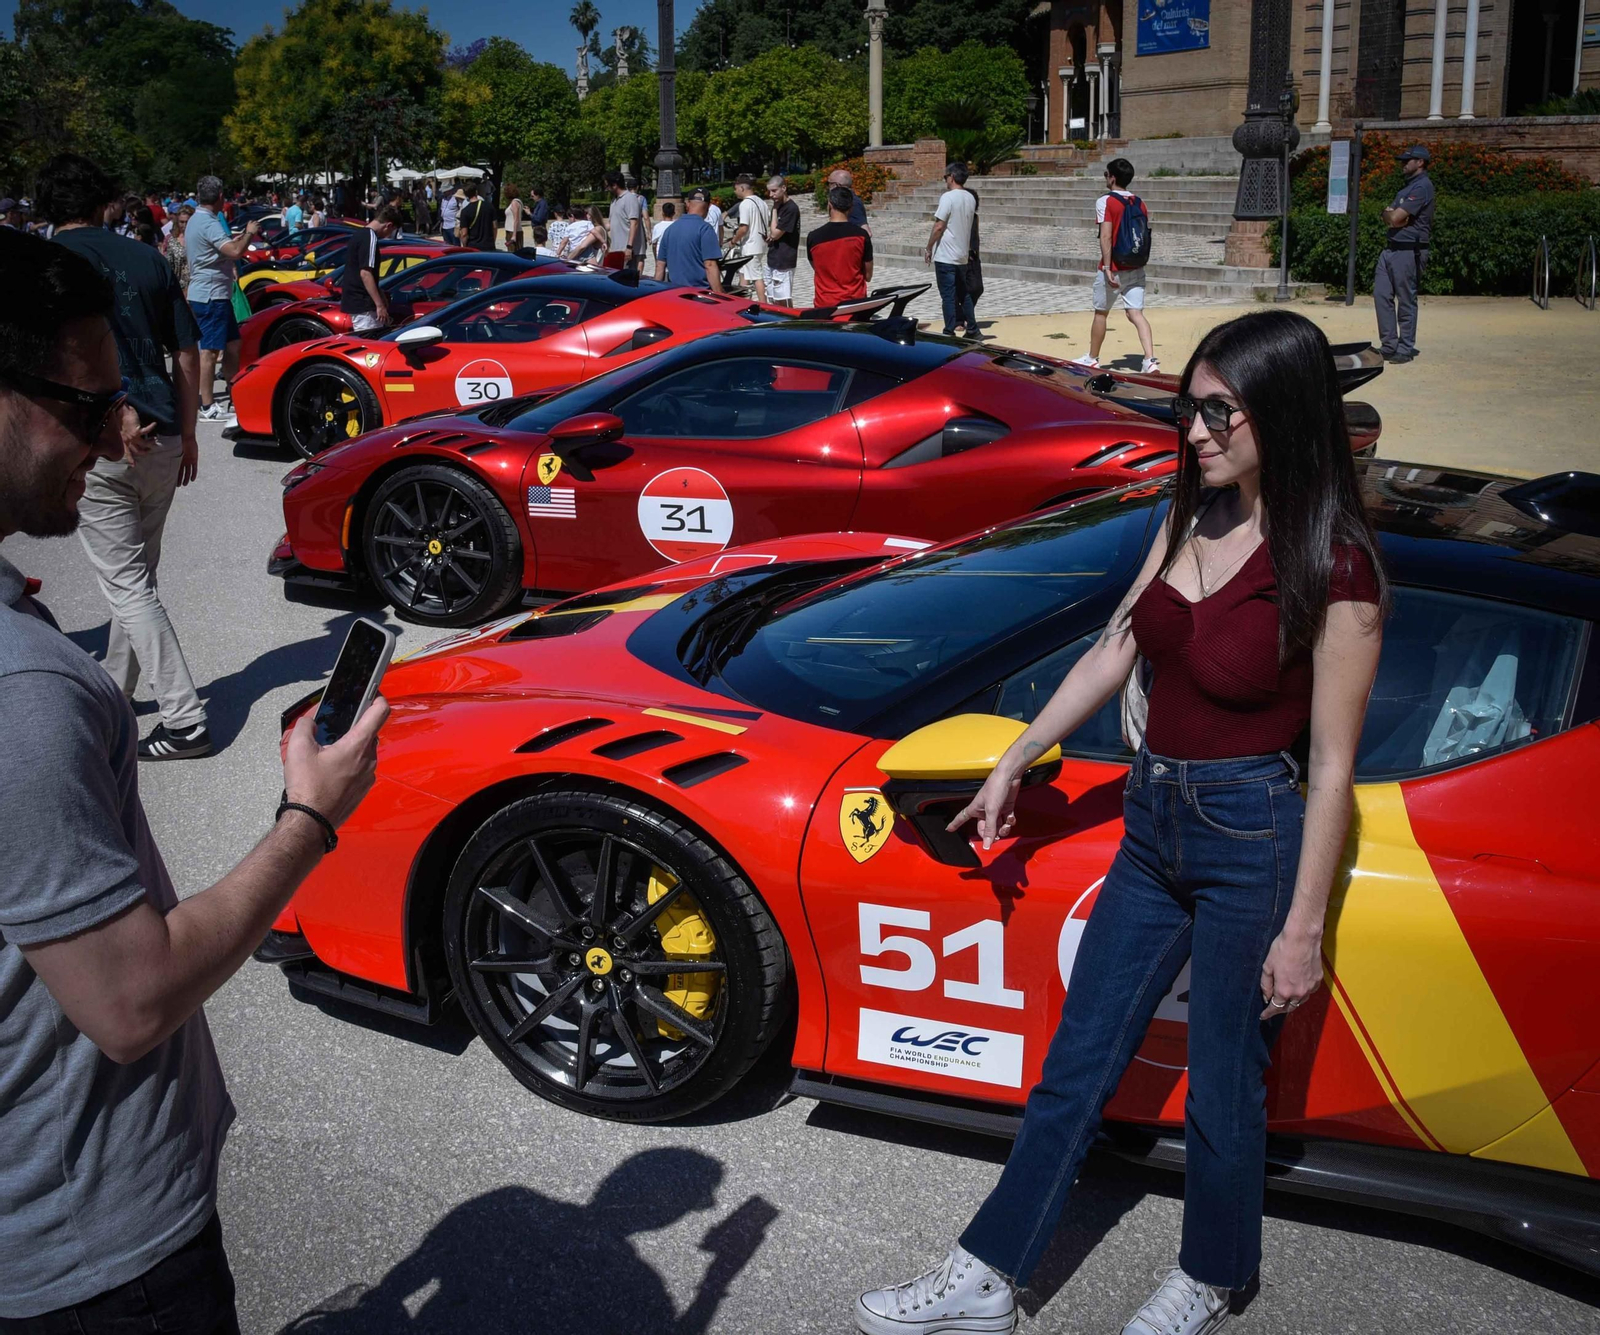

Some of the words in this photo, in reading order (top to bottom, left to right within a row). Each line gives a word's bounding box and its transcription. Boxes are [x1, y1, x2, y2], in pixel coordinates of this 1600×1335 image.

[467, 382, 500, 401] 30
[660, 503, 713, 533] 31
[858, 901, 1025, 1010] 51
[891, 1026, 990, 1056] WEC
[889, 1053, 949, 1068] CHAMPIONSHIP
[904, 1049, 932, 1059] WORLD
[933, 1055, 981, 1068] ENDURANCE
